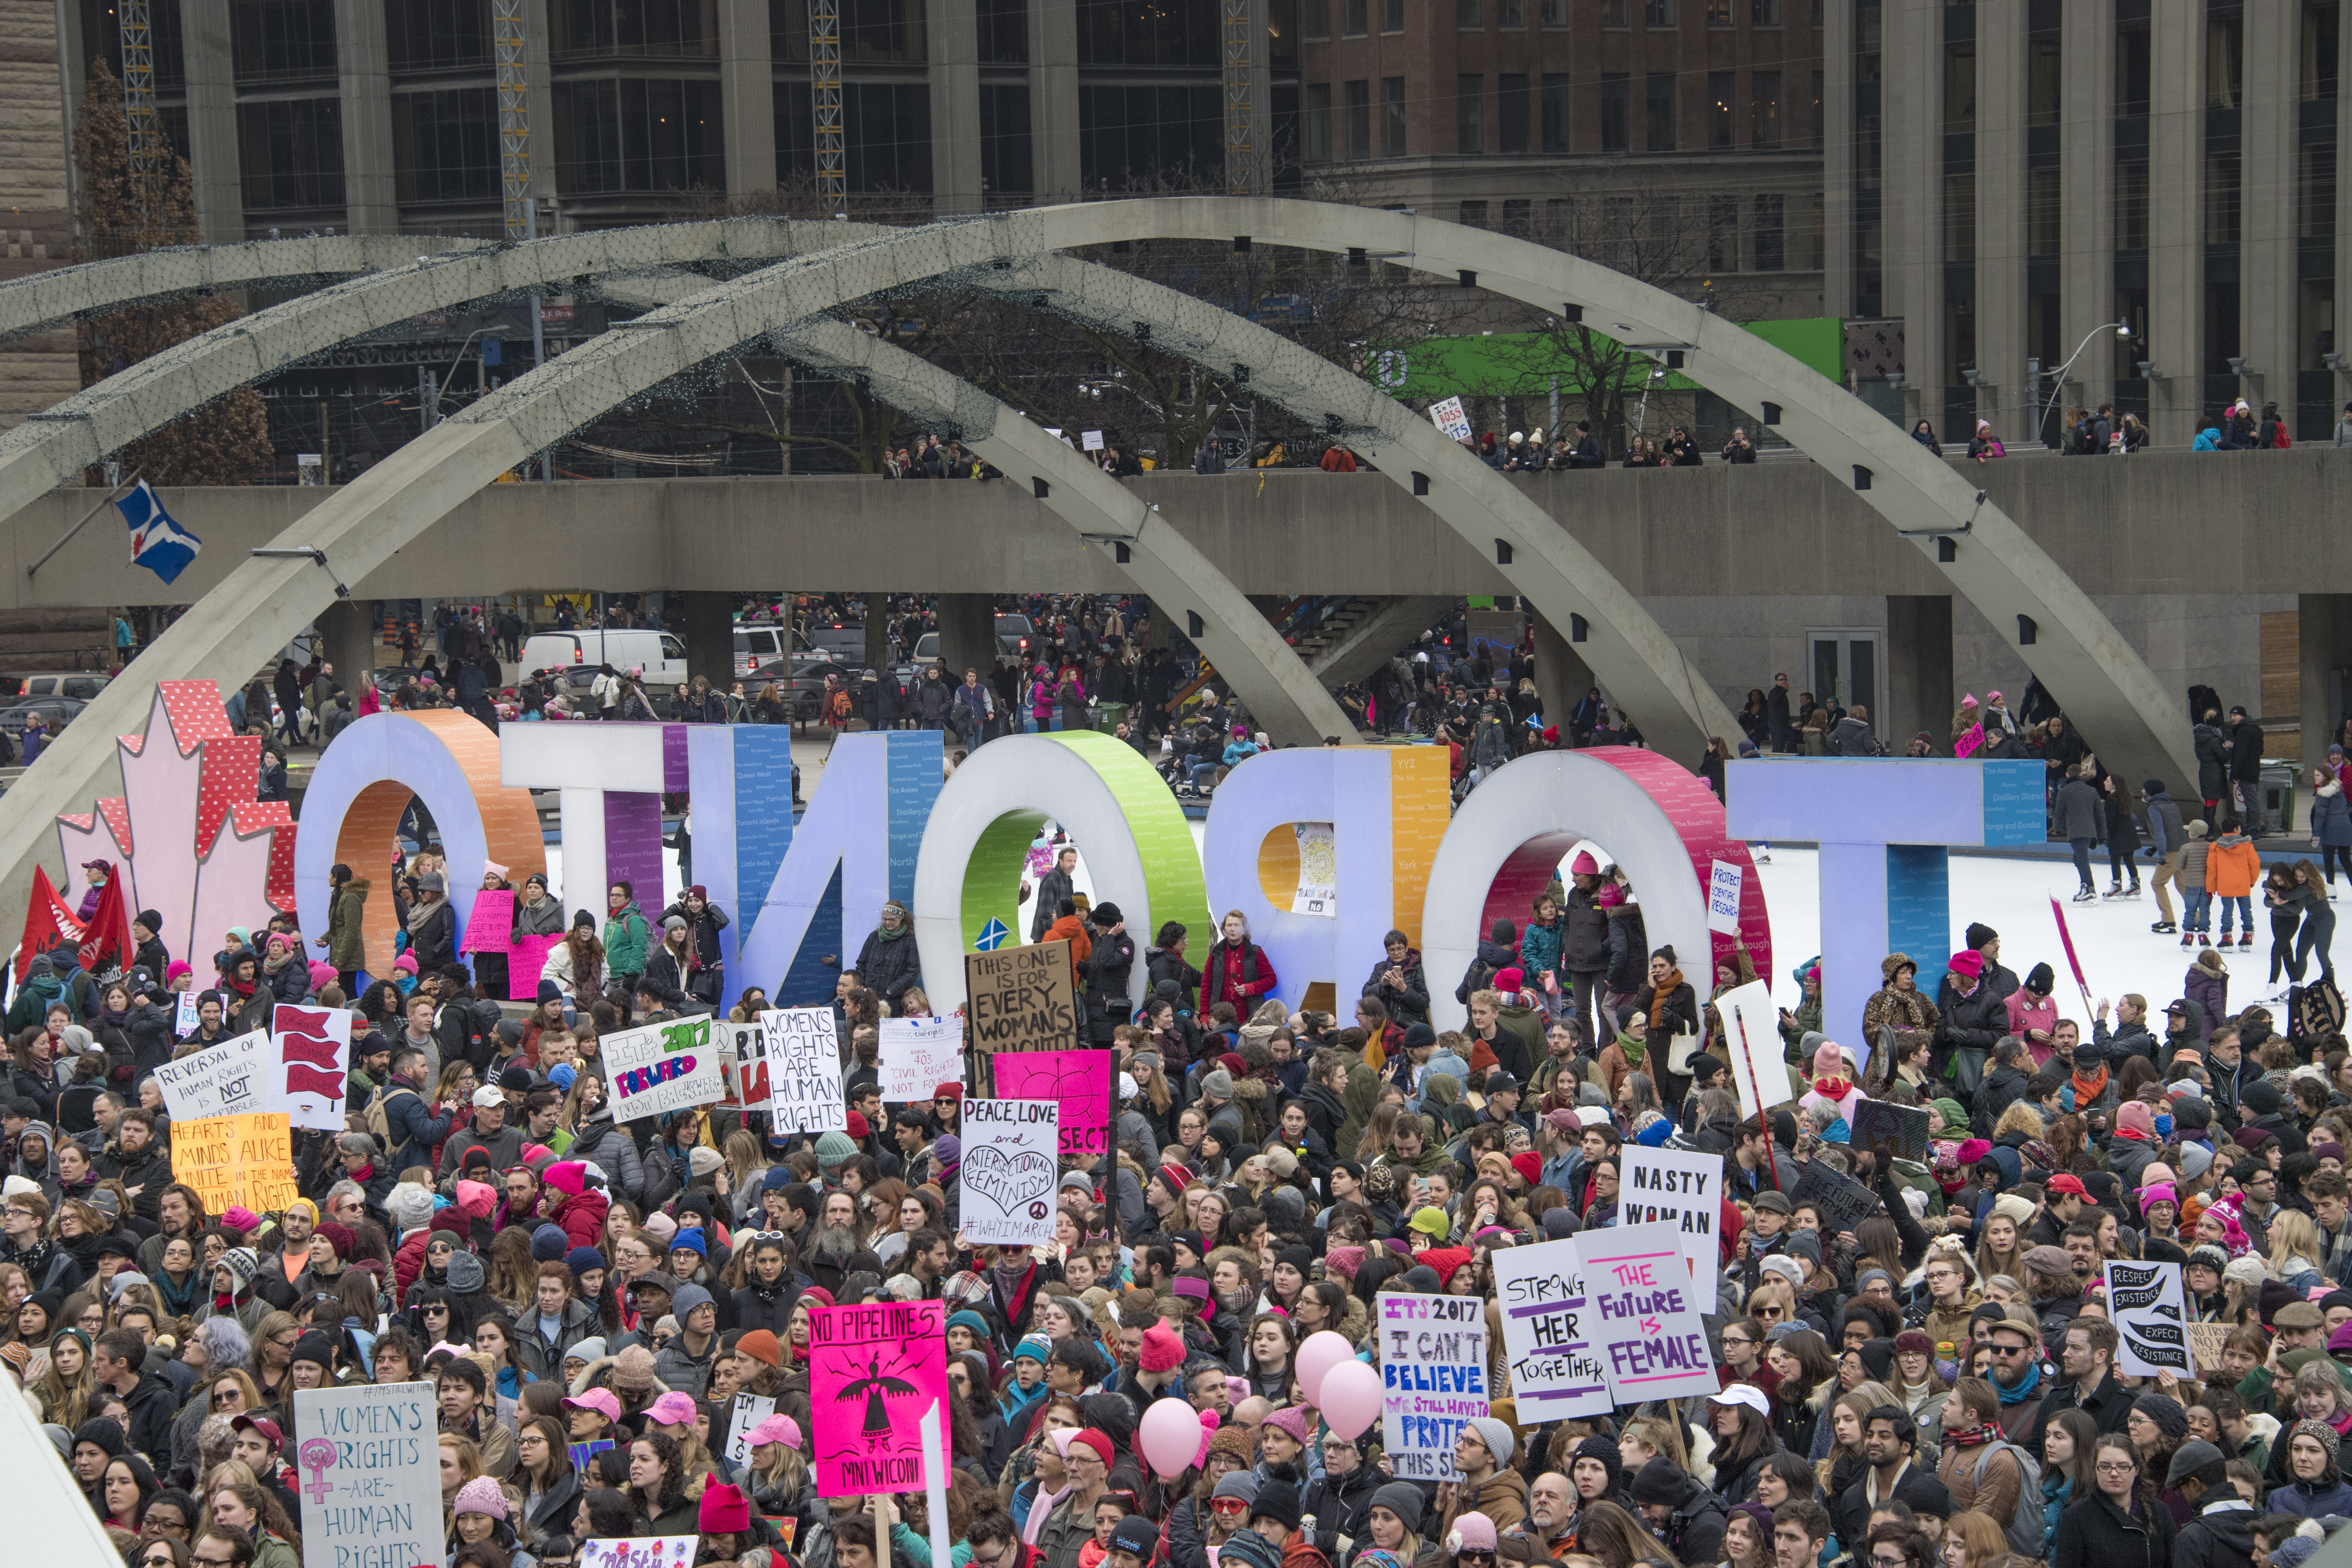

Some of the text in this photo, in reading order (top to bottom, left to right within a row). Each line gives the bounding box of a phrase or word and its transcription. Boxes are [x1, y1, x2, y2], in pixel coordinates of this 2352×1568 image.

[1434, 400, 1457, 414] I'm the
[1439, 407, 1461, 424] BOSS
[1446, 424, 1468, 440] ITS
[1398, 759, 1415, 769] YYZ
[1993, 793, 2020, 802] Distillery
[890, 857, 915, 867] North
[1147, 858, 1167, 867] York
[1398, 860, 1417, 870] York
[1706, 847, 1748, 859] East York
[612, 867, 630, 876] YYZ
[1714, 868, 1740, 887] PROTECT
[482, 893, 513, 905] NOT FREE
[1298, 888, 1328, 900] TEACH YOUR
[1711, 885, 1735, 902] SCIENTIFIC
[1310, 903, 1321, 912] NO
[1712, 899, 1738, 918] RESEARCH
[973, 949, 1060, 975] THIS ONE
[997, 969, 1051, 988] IS FOR
[976, 982, 1057, 1014] EVERY
[279, 1013, 295, 1024] OUR
[763, 1010, 832, 1035] WOMEN'S
[976, 1001, 1073, 1041] WOMAN'S
[285, 1039, 331, 1062] OUR MINDS
[608, 1018, 710, 1067] IT'S 2017
[735, 1029, 766, 1062] RAD
[769, 1034, 836, 1059] RIGHTS
[159, 1037, 258, 1086] REVERSAL OF
[785, 1057, 821, 1077] ARE
[914, 1054, 932, 1065] 403
[178, 1059, 257, 1101] HUMAN RIGHTS
[307, 1078, 336, 1094] POWER
[615, 1055, 697, 1099] FORWARD
[740, 1060, 771, 1106] LO
[771, 1075, 842, 1103] HUMAN
[892, 1074, 950, 1094] NOT FOUND
[198, 1075, 250, 1109] IS NOT
[619, 1076, 722, 1120] NOT BACKWARD
[194, 1098, 260, 1121] CCEPTABLE
[777, 1103, 843, 1131] RIGHTS
[964, 1100, 1058, 1127] PEACE, LOVE,
[172, 1114, 279, 1140] HEARTS AND
[990, 1133, 1034, 1146] and
[180, 1138, 287, 1167] MINDS ALIKE
[966, 1149, 1051, 1179] INTERSECTIONAL
[176, 1166, 292, 1187] UNITE IN THE NAM
[967, 1170, 1048, 1206] FEMINISM
[1634, 1166, 1708, 1195] NASTY
[1811, 1172, 1869, 1216] THE FUTURE
[1626, 1203, 1710, 1235] WOMAN
[1820, 1197, 1855, 1225] FEMALE
[963, 1216, 1053, 1240] #WHYIMARCH
[1611, 1263, 1657, 1287] THE
[2114, 1269, 2153, 1283] RESPECT
[1507, 1273, 1585, 1302] STRONG
[2116, 1286, 2160, 1306] EXISTENCE
[1385, 1298, 1478, 1322] IT'S 2017
[1597, 1288, 1686, 1321] FUTURE
[810, 1306, 940, 1342] NO PIPELINES
[1531, 1313, 1579, 1348] HER
[1640, 1316, 1662, 1336] IS
[2146, 1328, 2178, 1340] EXPECT
[2187, 1324, 2204, 1336] NO
[1390, 1330, 1483, 1364] I CAN'T
[1607, 1334, 1709, 1375] FEMALE
[2133, 1343, 2183, 1363] RESISTANCE
[2195, 1337, 2212, 1348] NO
[2196, 1348, 2208, 1357] NO
[1385, 1364, 1483, 1394] BELIEVE
[1512, 1353, 1605, 1383] TOGETHER
[319, 1402, 422, 1435] WOMEN'S
[1386, 1396, 1489, 1417] WE STILL HAVE TO
[1401, 1415, 1469, 1449] PROTE
[333, 1438, 419, 1469] RIGHTS
[1388, 1452, 1434, 1476] THIS
[841, 1457, 918, 1487] MNI WICONI
[324, 1503, 412, 1538] HUMAN
[1117, 1542, 1137, 1552] ANIMALS
